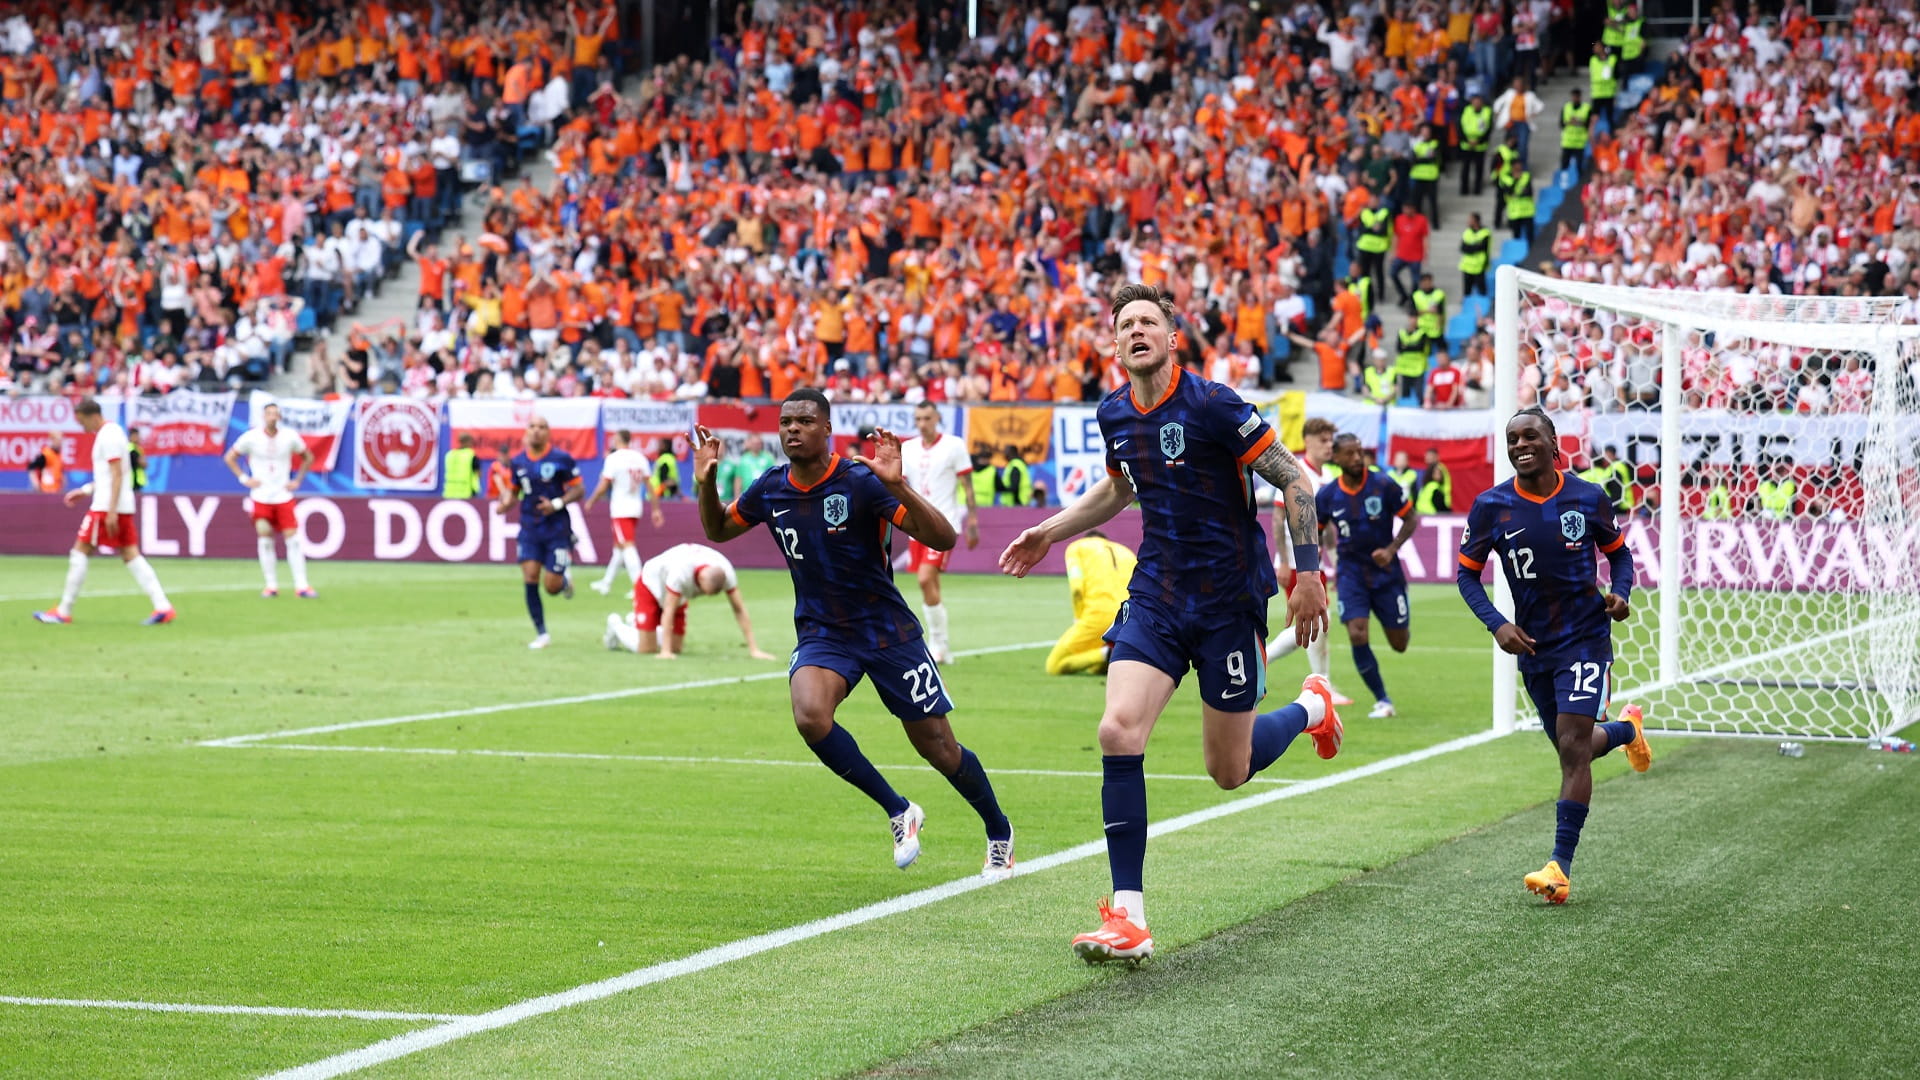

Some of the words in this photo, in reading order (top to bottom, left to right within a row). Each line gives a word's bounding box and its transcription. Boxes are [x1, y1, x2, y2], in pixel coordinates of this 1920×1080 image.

[98, 496, 221, 556] LY
[1507, 547, 1537, 579] 12
[1622, 519, 1917, 588] ARWAY
[902, 662, 939, 704] 22
[1226, 650, 1247, 685] 9
[1569, 661, 1600, 693] 12
